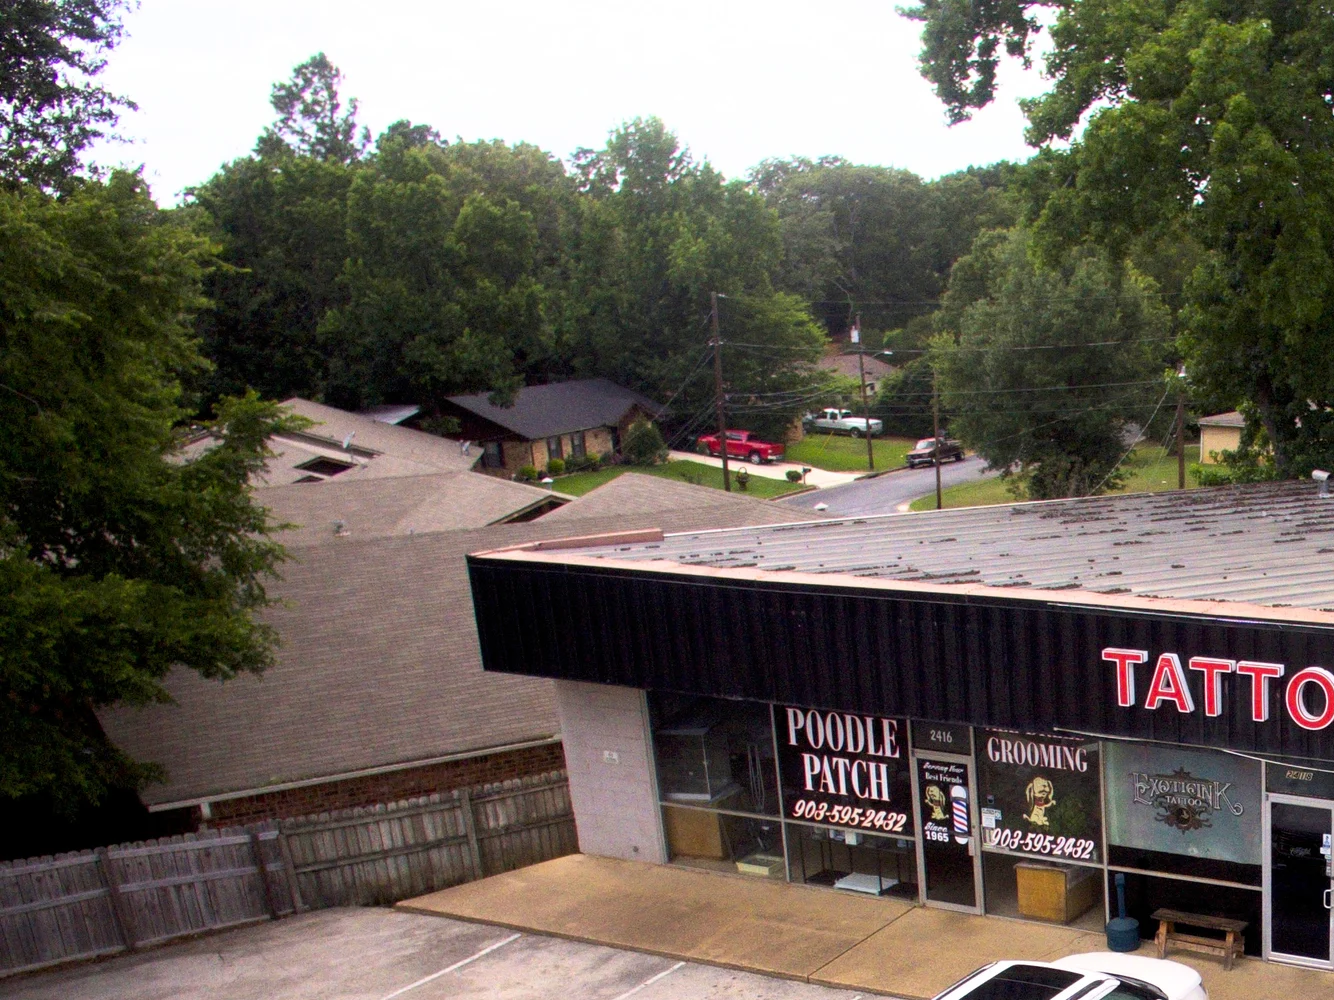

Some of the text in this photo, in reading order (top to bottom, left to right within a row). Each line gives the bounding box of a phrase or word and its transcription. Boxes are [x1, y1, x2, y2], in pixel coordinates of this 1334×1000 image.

[786, 707, 900, 759] POODLE
[930, 730, 953, 743] 2416
[987, 737, 1088, 773] GROOMING
[802, 753, 890, 801] PATCH
[1285, 770, 1314, 781] 2418
[792, 799, 907, 832] 903-595-2432
[1166, 796, 1202, 807] TATTOO
[925, 831, 949, 842] 1965
[991, 828, 1094, 859] 903-595-2432
